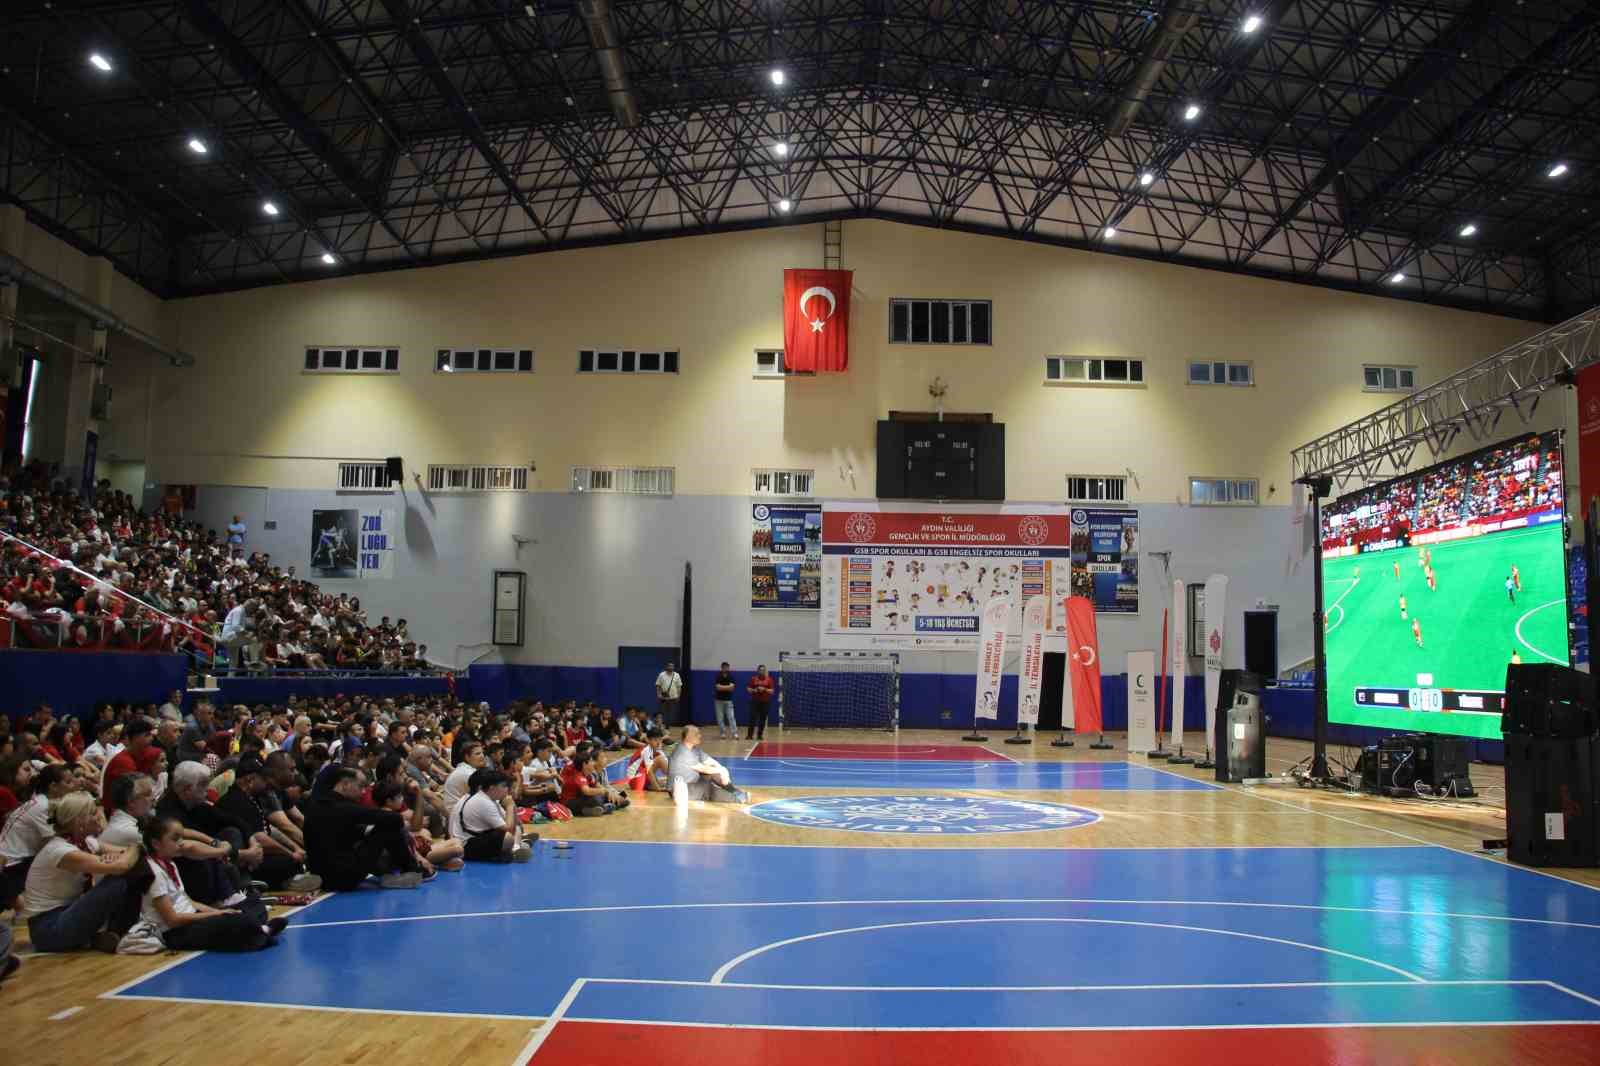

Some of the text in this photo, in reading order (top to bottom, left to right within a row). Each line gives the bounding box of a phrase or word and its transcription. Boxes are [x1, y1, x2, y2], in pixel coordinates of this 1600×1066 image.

[362, 516, 381, 531] ZOR
[945, 524, 974, 532] VALİLİĞİ
[889, 532, 919, 541] GENÇLİK
[931, 533, 950, 541] SPOR
[959, 532, 1006, 542] MÜDÜRLÜĞÜ
[870, 547, 889, 555] SPOR
[890, 547, 926, 555] OKULLARI
[935, 548, 949, 556] GSB
[949, 548, 981, 556] ENGELSİZ
[984, 549, 1004, 557] SPOR
[1004, 549, 1040, 557] OKULLARI
[1096, 554, 1111, 562] SPOR
